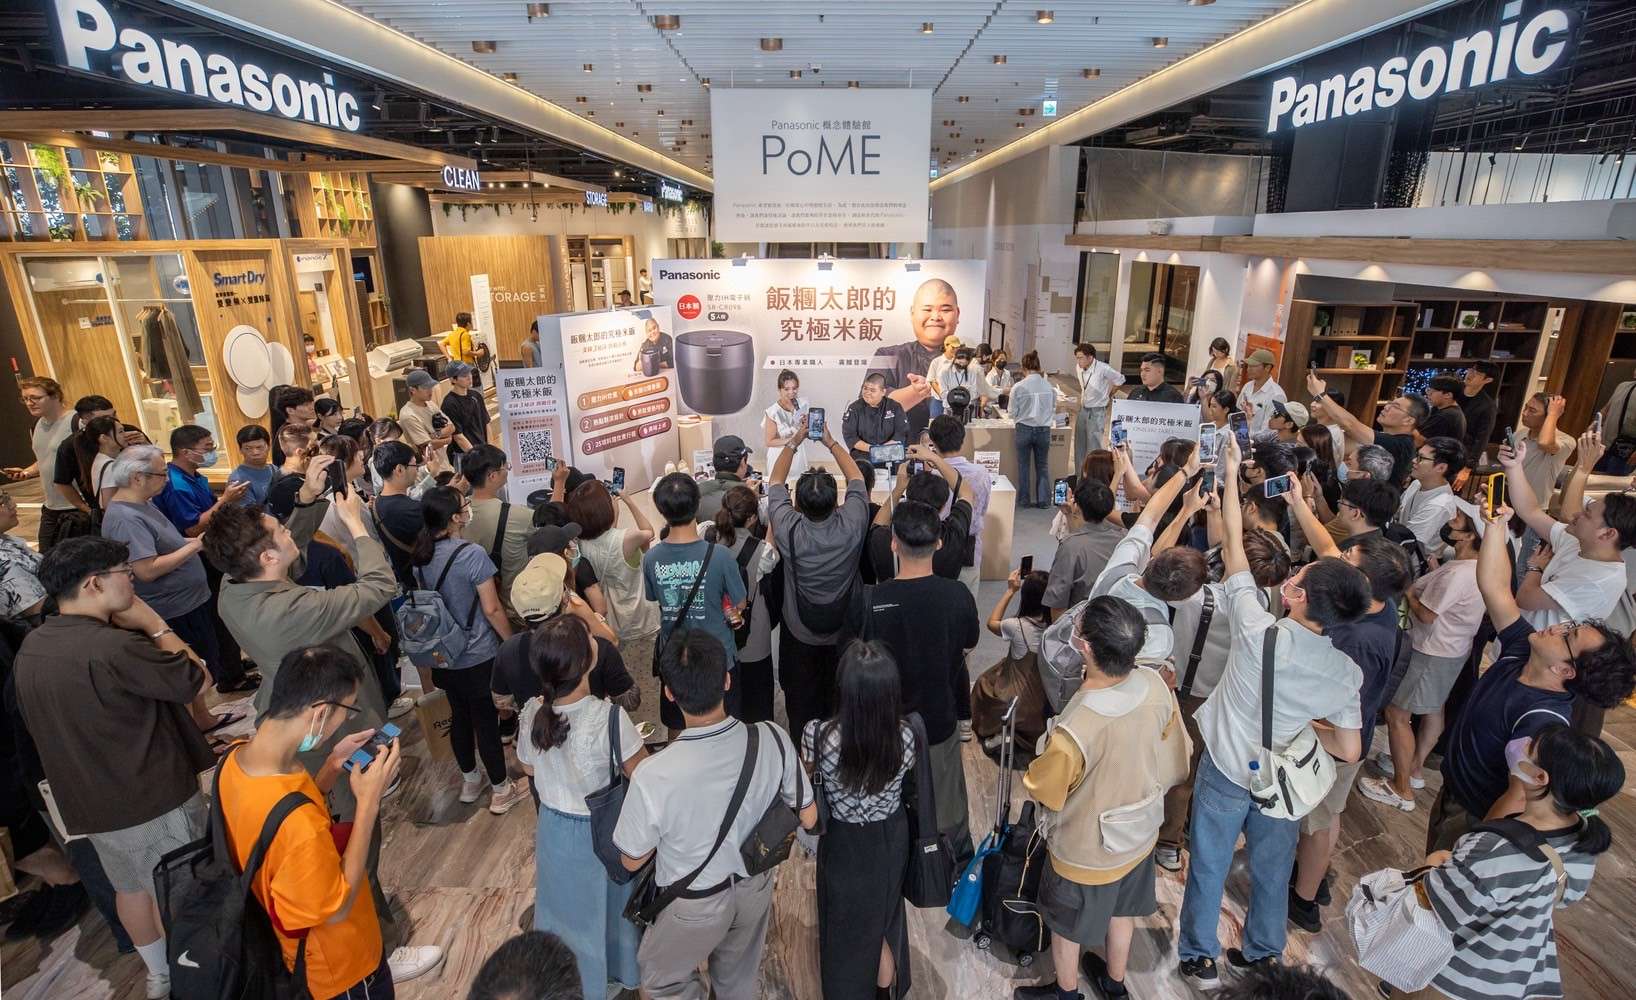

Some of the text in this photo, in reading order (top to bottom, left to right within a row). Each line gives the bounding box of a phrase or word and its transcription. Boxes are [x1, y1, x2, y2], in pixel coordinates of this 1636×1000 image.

[54, 0, 361, 132] Panasonic
[1267, 0, 1569, 133] Panasonic
[771, 120, 872, 131] Panasonic 概念體驗館
[762, 134, 881, 176] PoME
[443, 166, 481, 191] CLEAN
[586, 190, 608, 207] STORAGE
[659, 269, 721, 281] Panasonic
[489, 291, 537, 302] TORAGE
[766, 286, 897, 311] 飯糰太郎的
[780, 317, 884, 342] 究極米飯
[511, 387, 553, 399] 究極米飯
